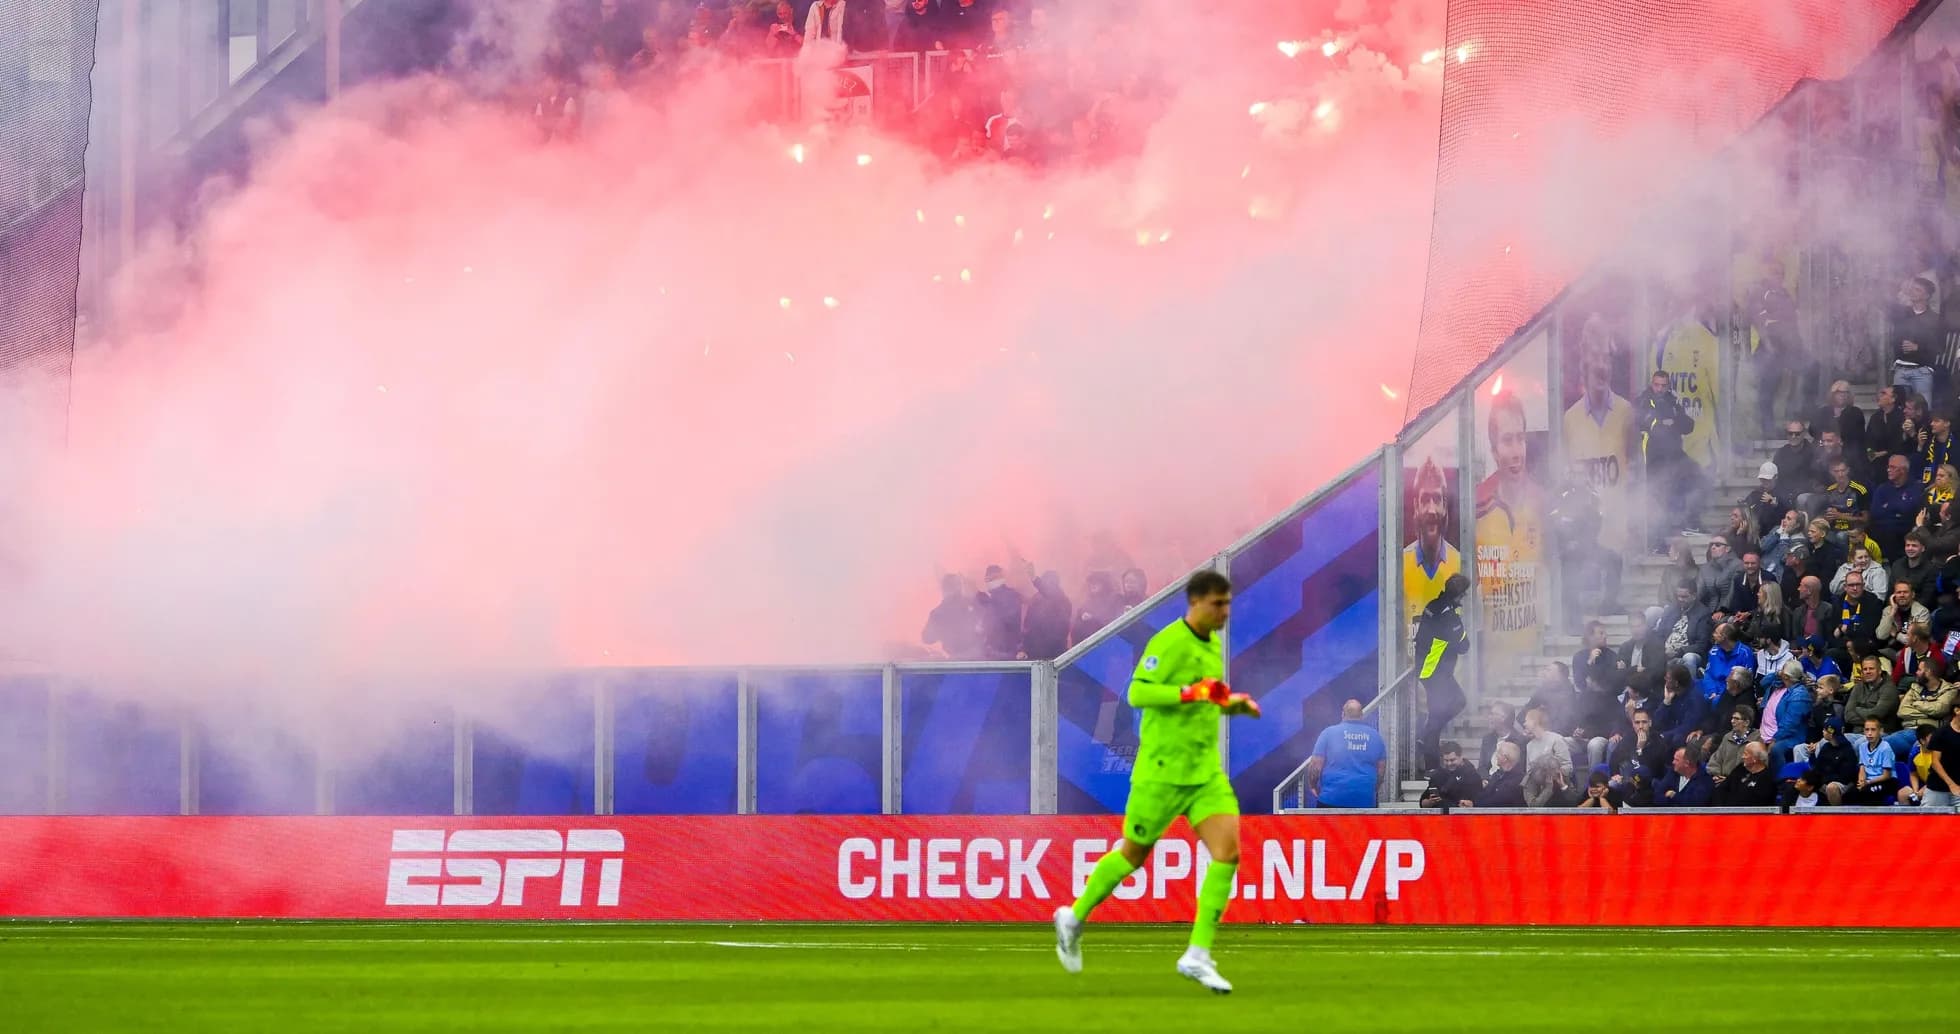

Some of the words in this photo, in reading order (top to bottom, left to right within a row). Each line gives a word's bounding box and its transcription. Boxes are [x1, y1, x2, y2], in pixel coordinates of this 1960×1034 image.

[1343, 730, 1370, 743] Security
[385, 829, 625, 906] ESPN
[838, 837, 1052, 899] CHECK
